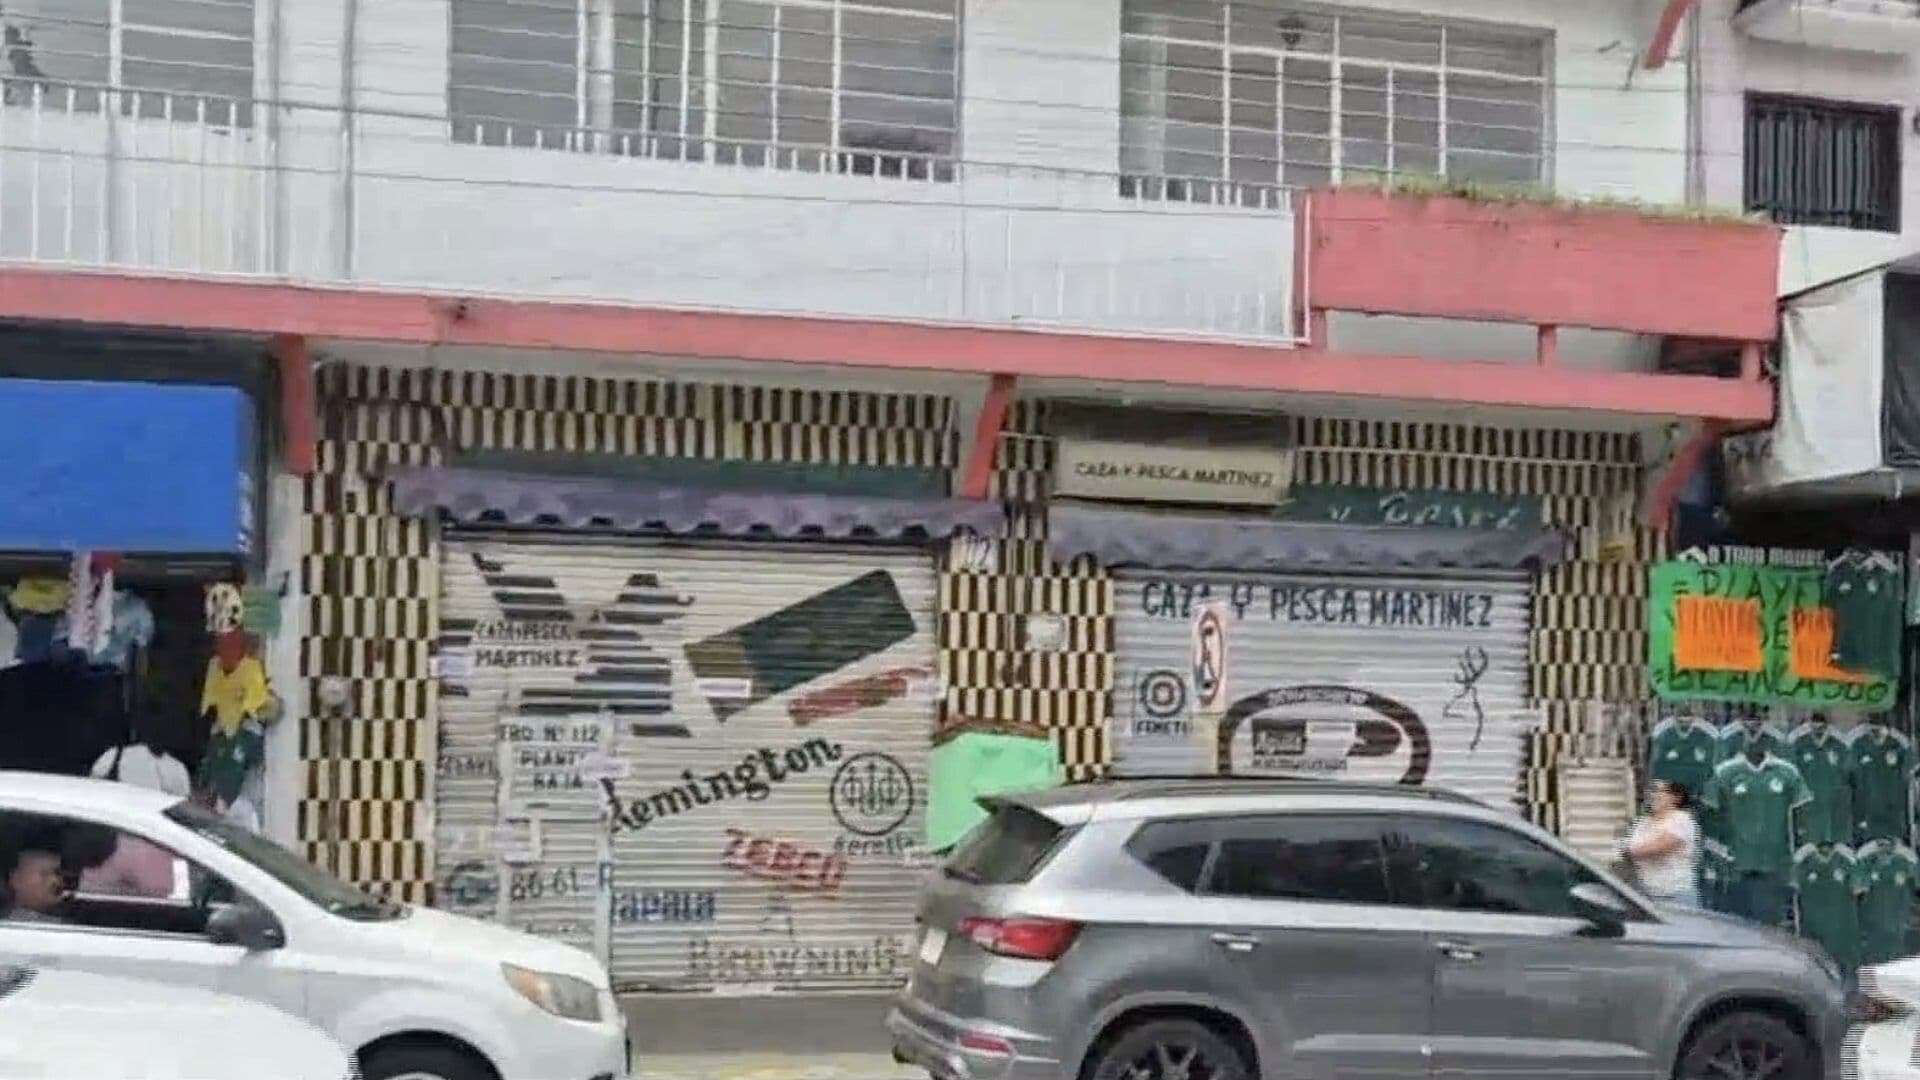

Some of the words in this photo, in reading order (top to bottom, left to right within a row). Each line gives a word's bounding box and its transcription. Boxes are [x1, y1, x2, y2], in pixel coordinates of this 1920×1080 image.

[1075, 461, 1118, 477] CAZA
[1136, 463, 1189, 481] PESCA
[1194, 468, 1274, 488] MARTINEZ
[1230, 584, 1252, 621] Y
[1270, 587, 1357, 623] PESCA
[1369, 591, 1494, 628] MARTINEZ
[475, 648, 580, 668] MARTINEZ
